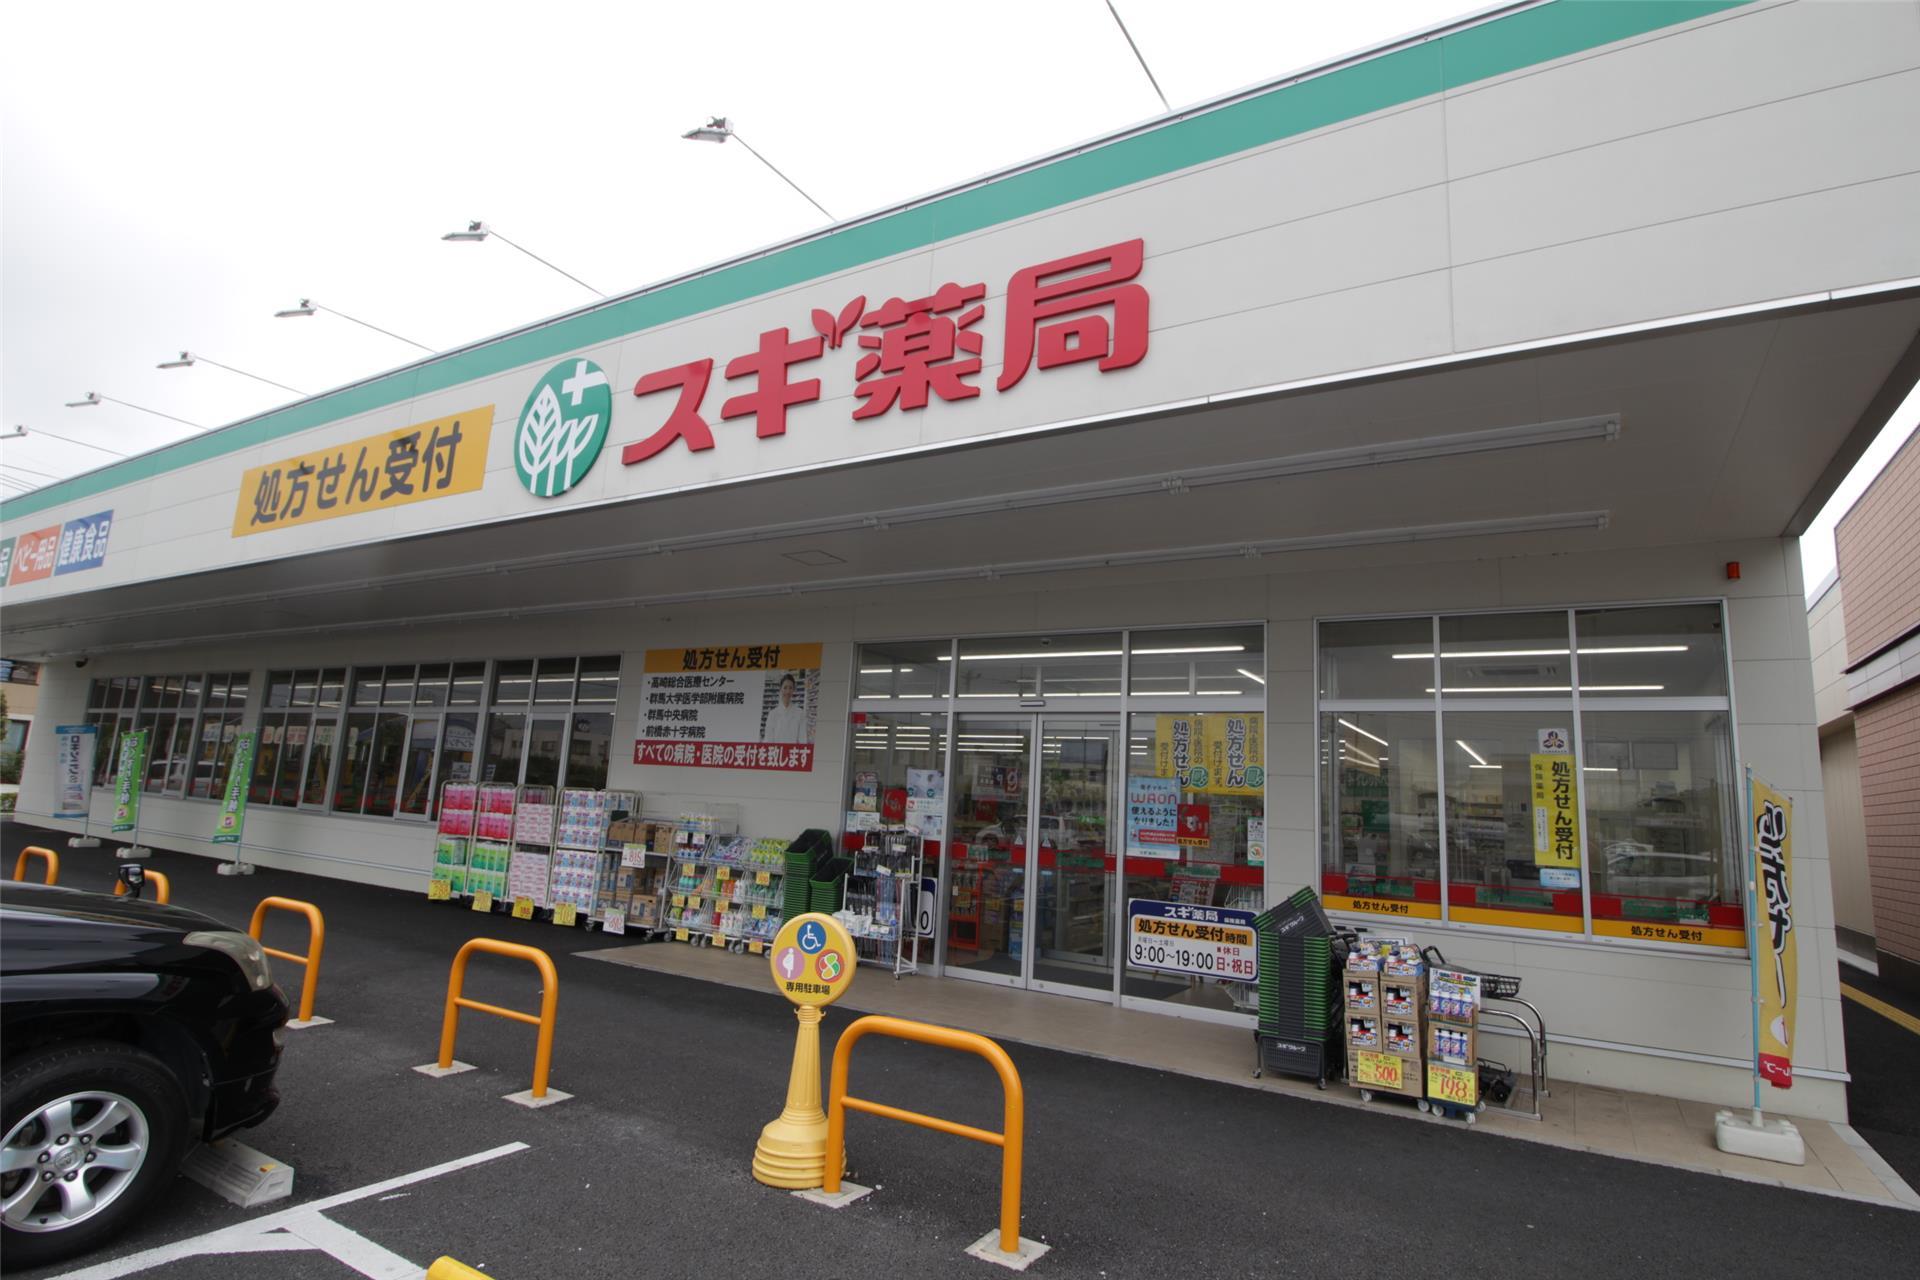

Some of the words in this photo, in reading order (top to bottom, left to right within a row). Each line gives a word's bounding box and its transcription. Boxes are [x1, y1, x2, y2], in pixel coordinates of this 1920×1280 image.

[622, 238, 1150, 465] スギ薬局
[250, 421, 462, 526] 処方せん受付
[682, 645, 780, 670] 処方せん受付
[636, 742, 811, 768] すべての病院・医院の受付を致します
[1226, 718, 1245, 788] 処方せん
[1131, 806, 1177, 817] 使えるように
[1551, 760, 1573, 861] 処方せん受付
[1164, 906, 1218, 922] スギ薬局
[1353, 900, 1409, 914] 処方せん受付
[1630, 924, 1703, 943] 処方せん受付
[785, 981, 831, 995] 専用駐車場
[1439, 1076, 1468, 1099] 198
